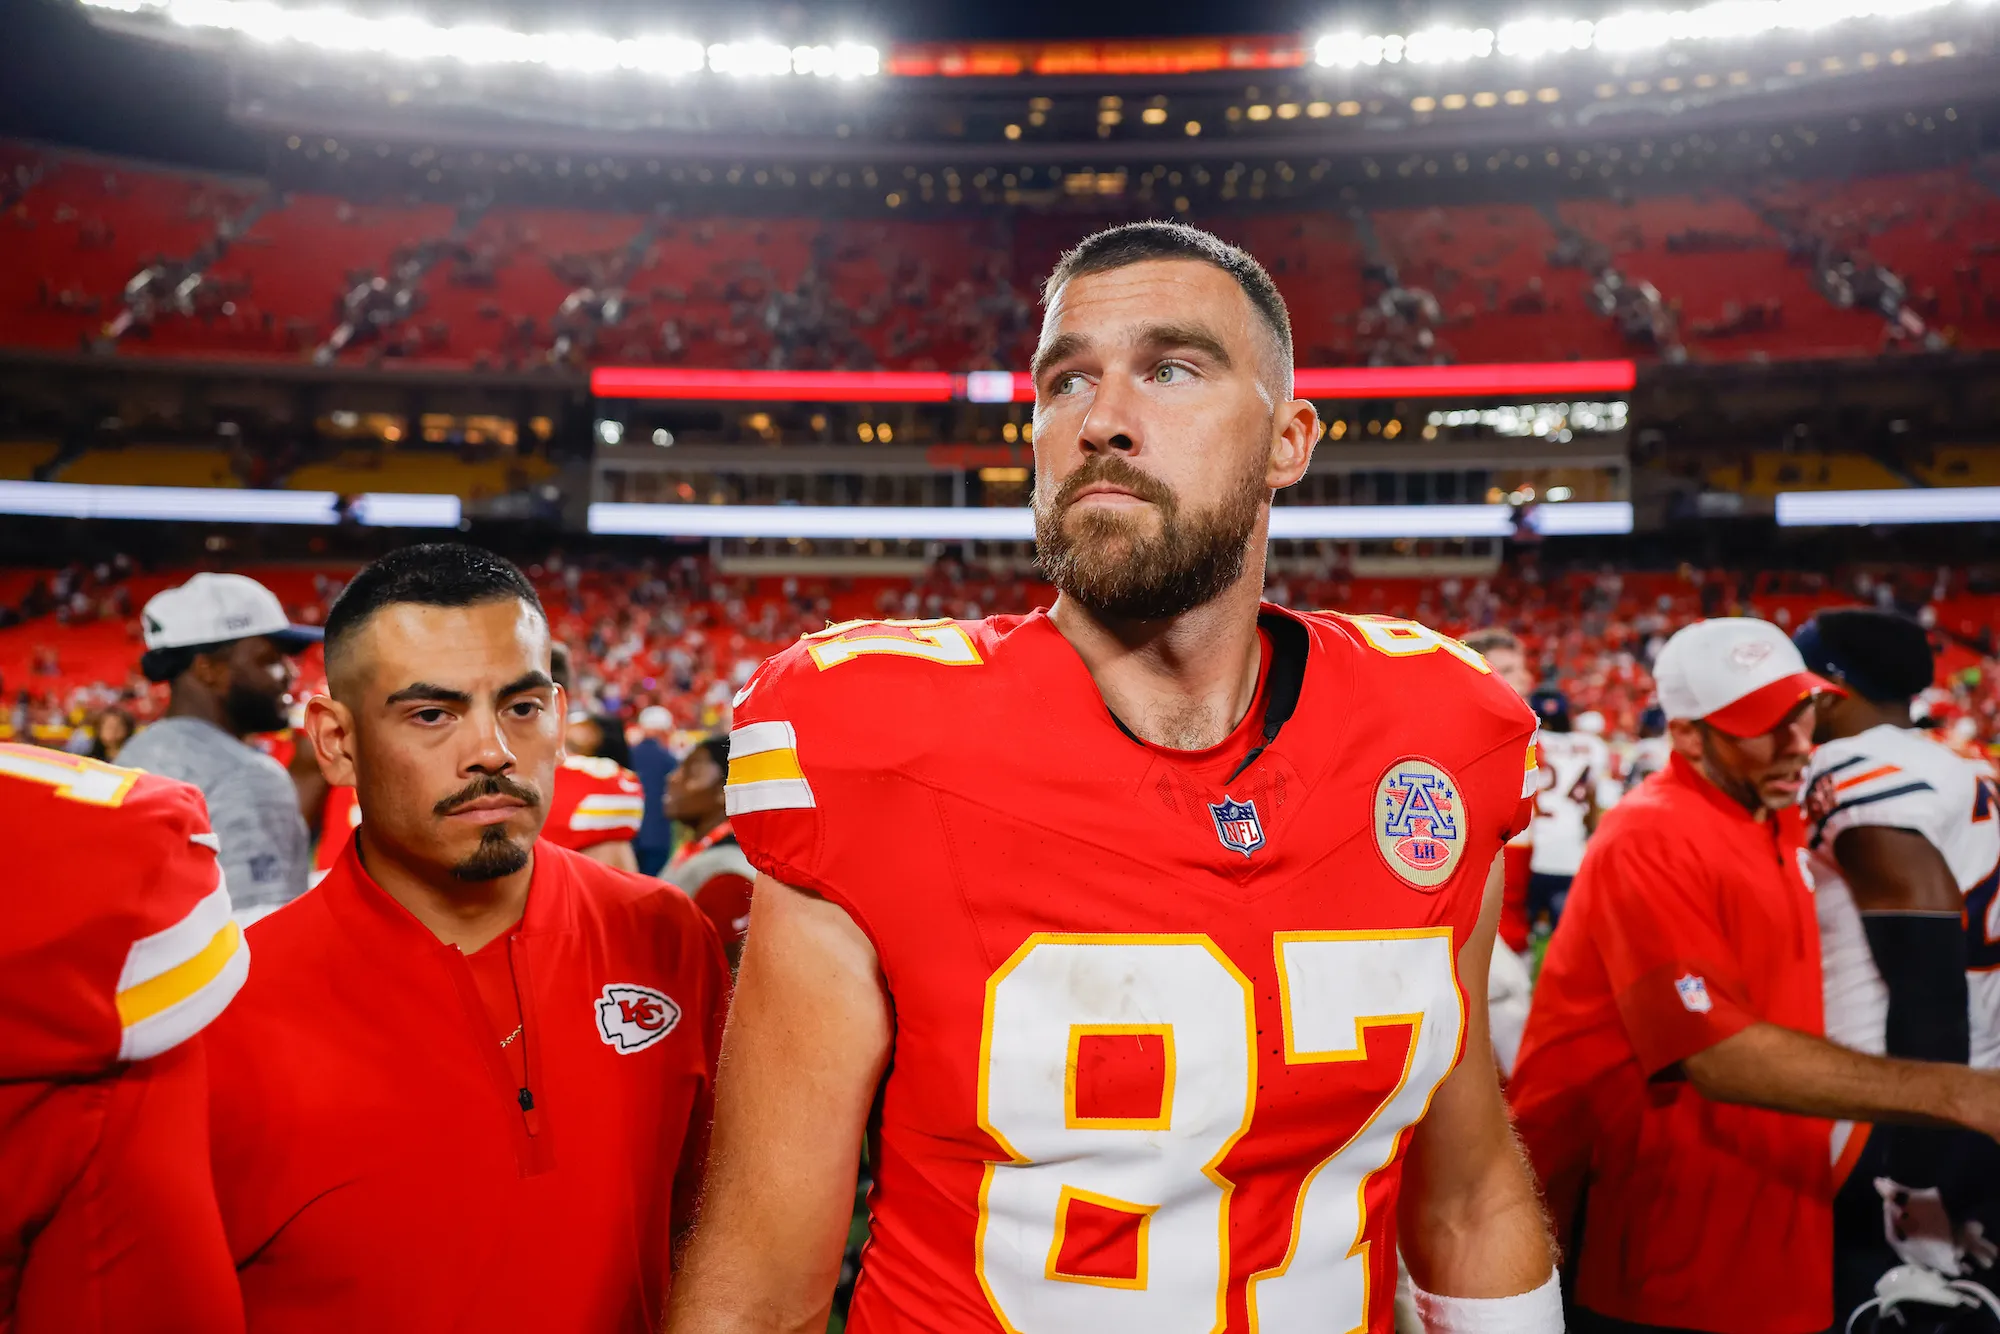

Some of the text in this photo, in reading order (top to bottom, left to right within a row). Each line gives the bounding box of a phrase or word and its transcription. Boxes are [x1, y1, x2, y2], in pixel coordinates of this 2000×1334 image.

[1385, 773, 1456, 839] A
[1224, 821, 1259, 845] NFL
[1413, 843, 1436, 859] LH
[618, 998, 665, 1030] KC
[975, 927, 1466, 1334] 87
